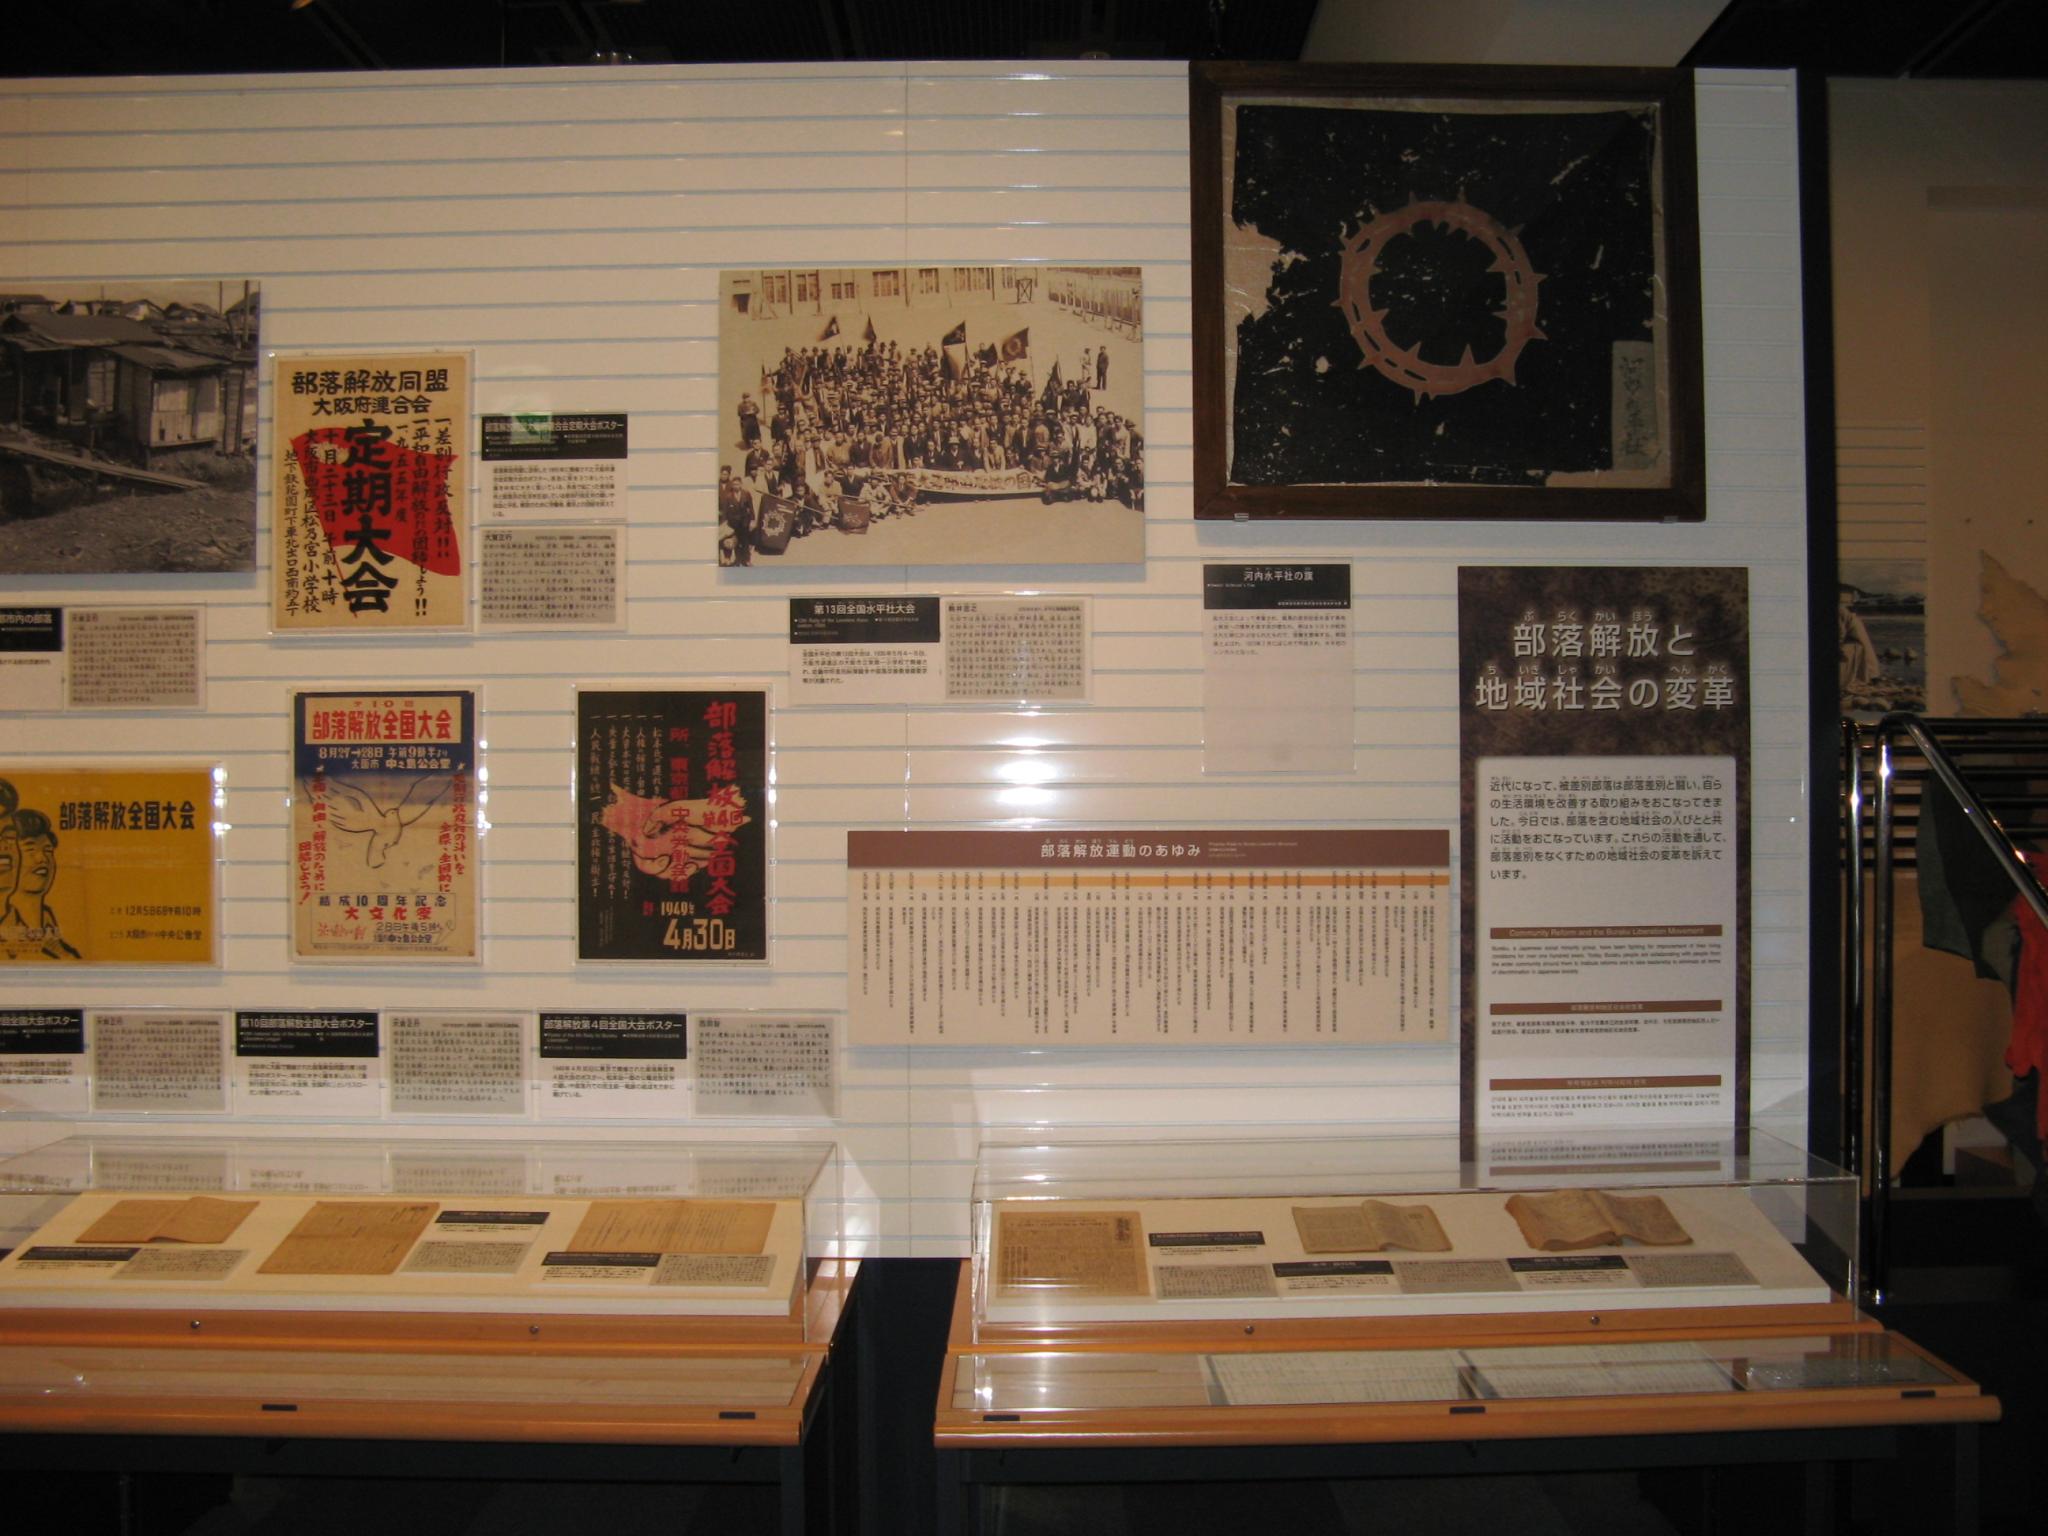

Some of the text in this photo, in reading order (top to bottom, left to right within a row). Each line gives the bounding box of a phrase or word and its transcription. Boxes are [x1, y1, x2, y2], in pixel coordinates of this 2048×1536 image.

[291, 369, 449, 396] 部落解放同盟
[312, 395, 432, 417] 大阪府連合会
[341, 418, 399, 614] 定期大会
[1244, 570, 1314, 582] 河内水平社の旗
[814, 603, 916, 615] 第13回全国水平社大会
[1513, 623, 1694, 658] 部落解放と
[1475, 675, 1734, 711] 地域社会の変革
[312, 710, 452, 741] 部落解放全国大会
[1490, 797, 1721, 810] の生活環境を改善する取り組みをおこなってきま
[59, 801, 196, 830] 部落解放全国大会
[1041, 843, 1201, 858] 部落解放運動のあゆみ
[1490, 850, 1722, 862] 部落差別をなくすための地域社会の変革を訴えて
[1490, 868, 1527, 881] います。
[661, 901, 694, 916] 1949年
[663, 918, 735, 950] 4月30日
[1593, 928, 1605, 936] the
[1607, 927, 1631, 936] Buraku
[240, 1018, 375, 1029] 第10回部落解放全国大会ポスター
[543, 1018, 683, 1030] 部落解放第4回全国大会ポスター
